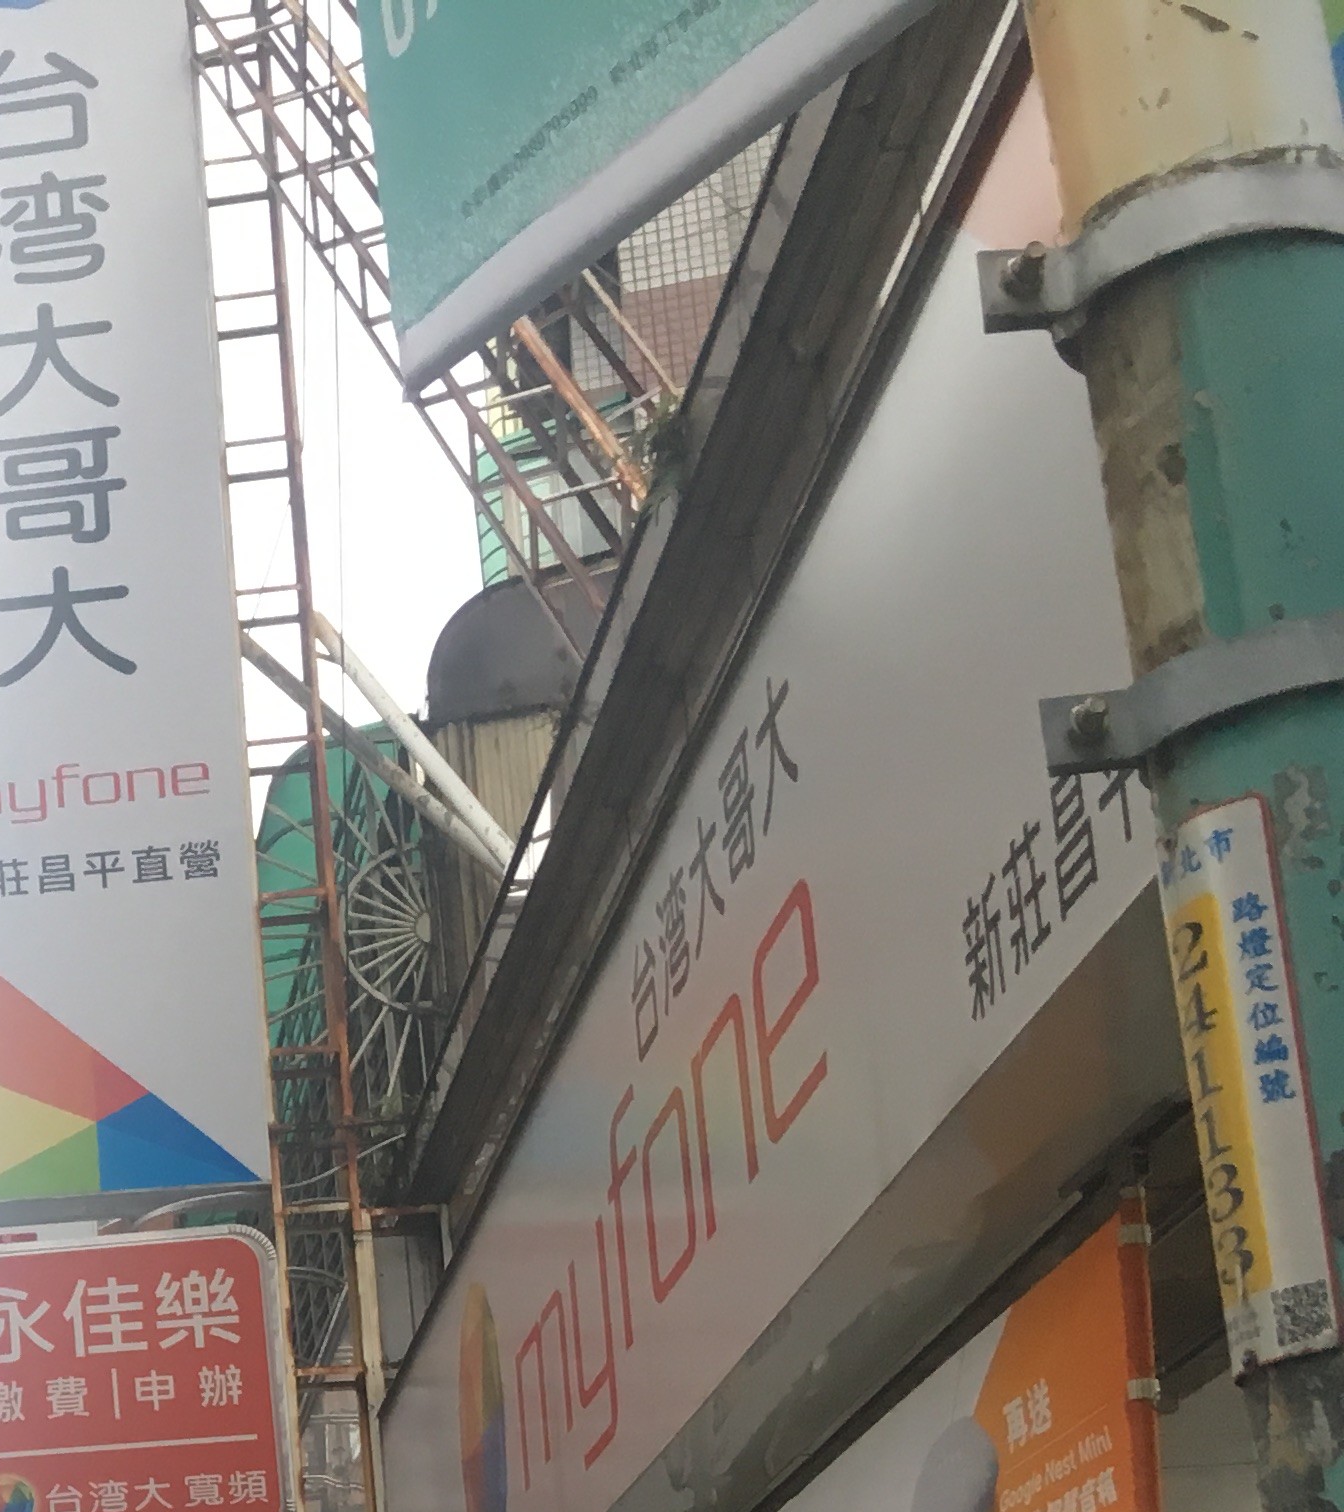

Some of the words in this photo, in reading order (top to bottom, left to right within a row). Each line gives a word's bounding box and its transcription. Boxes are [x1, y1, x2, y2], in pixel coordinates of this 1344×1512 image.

[629, 675, 800, 1064] 台湾大哥大
[1231, 889, 1297, 1105] 路燈定位編號
[513, 878, 829, 1492] myfone
[999, 1472, 1043, 1512] Google
[1044, 1448, 1078, 1486] Nest
[1078, 1424, 1113, 1465] Mini
[1002, 1377, 1053, 1454] 再送
